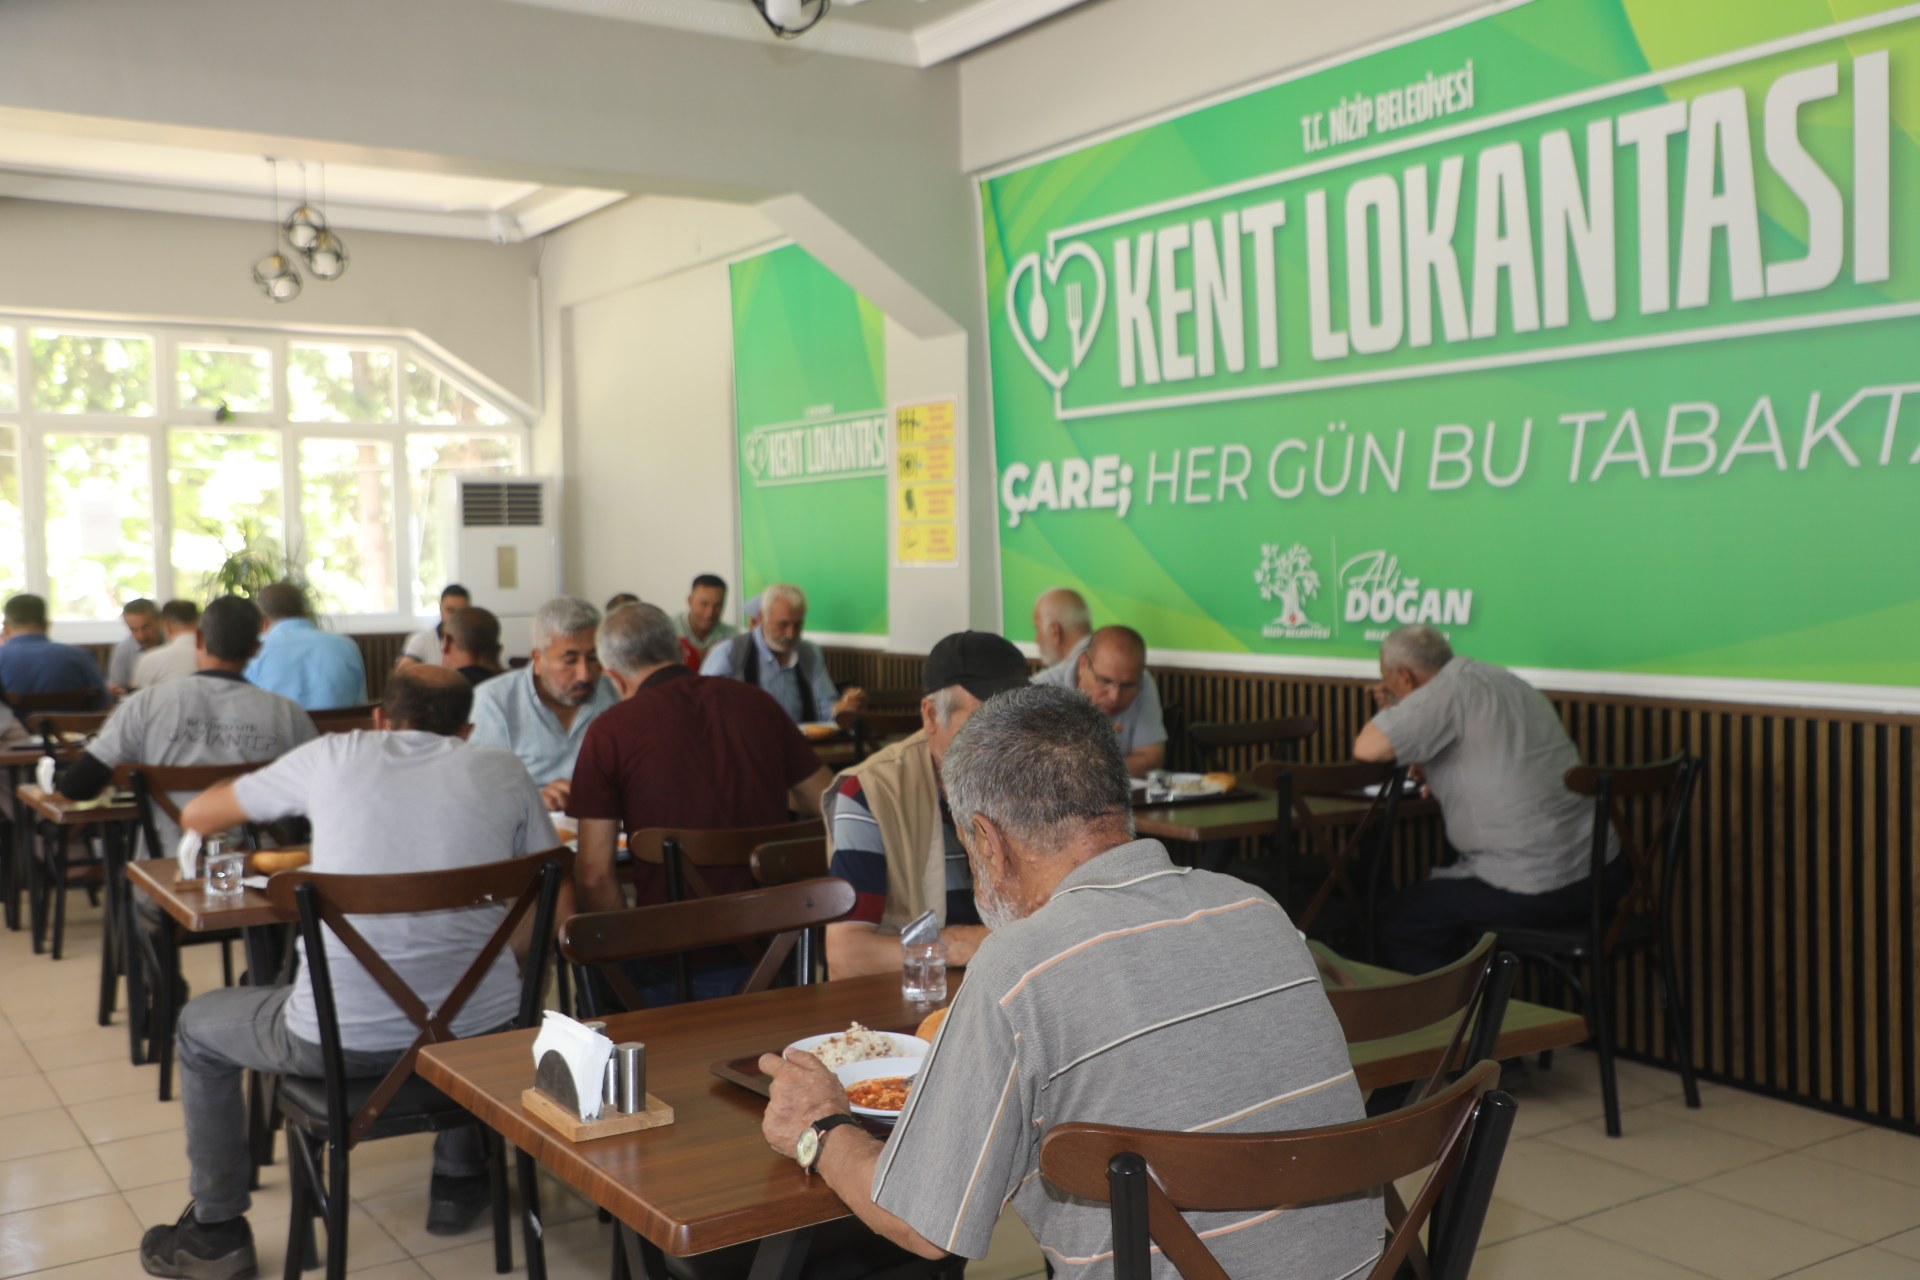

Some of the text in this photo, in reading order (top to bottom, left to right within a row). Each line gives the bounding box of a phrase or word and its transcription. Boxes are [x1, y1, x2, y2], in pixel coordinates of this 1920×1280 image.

[1301, 58, 1474, 153] T.C. NİZİP BELEDİYESİ
[1113, 48, 1890, 388] KENT LOKANTASI
[769, 428, 804, 478] KENT
[1001, 453, 1134, 528] ÇARE;
[1145, 443, 1253, 505] HER
[1266, 421, 1406, 499] GÜN
[1427, 417, 1533, 491] BU
[1557, 382, 1920, 482] TABAKT
[1344, 577, 1473, 625] DOĞAN
